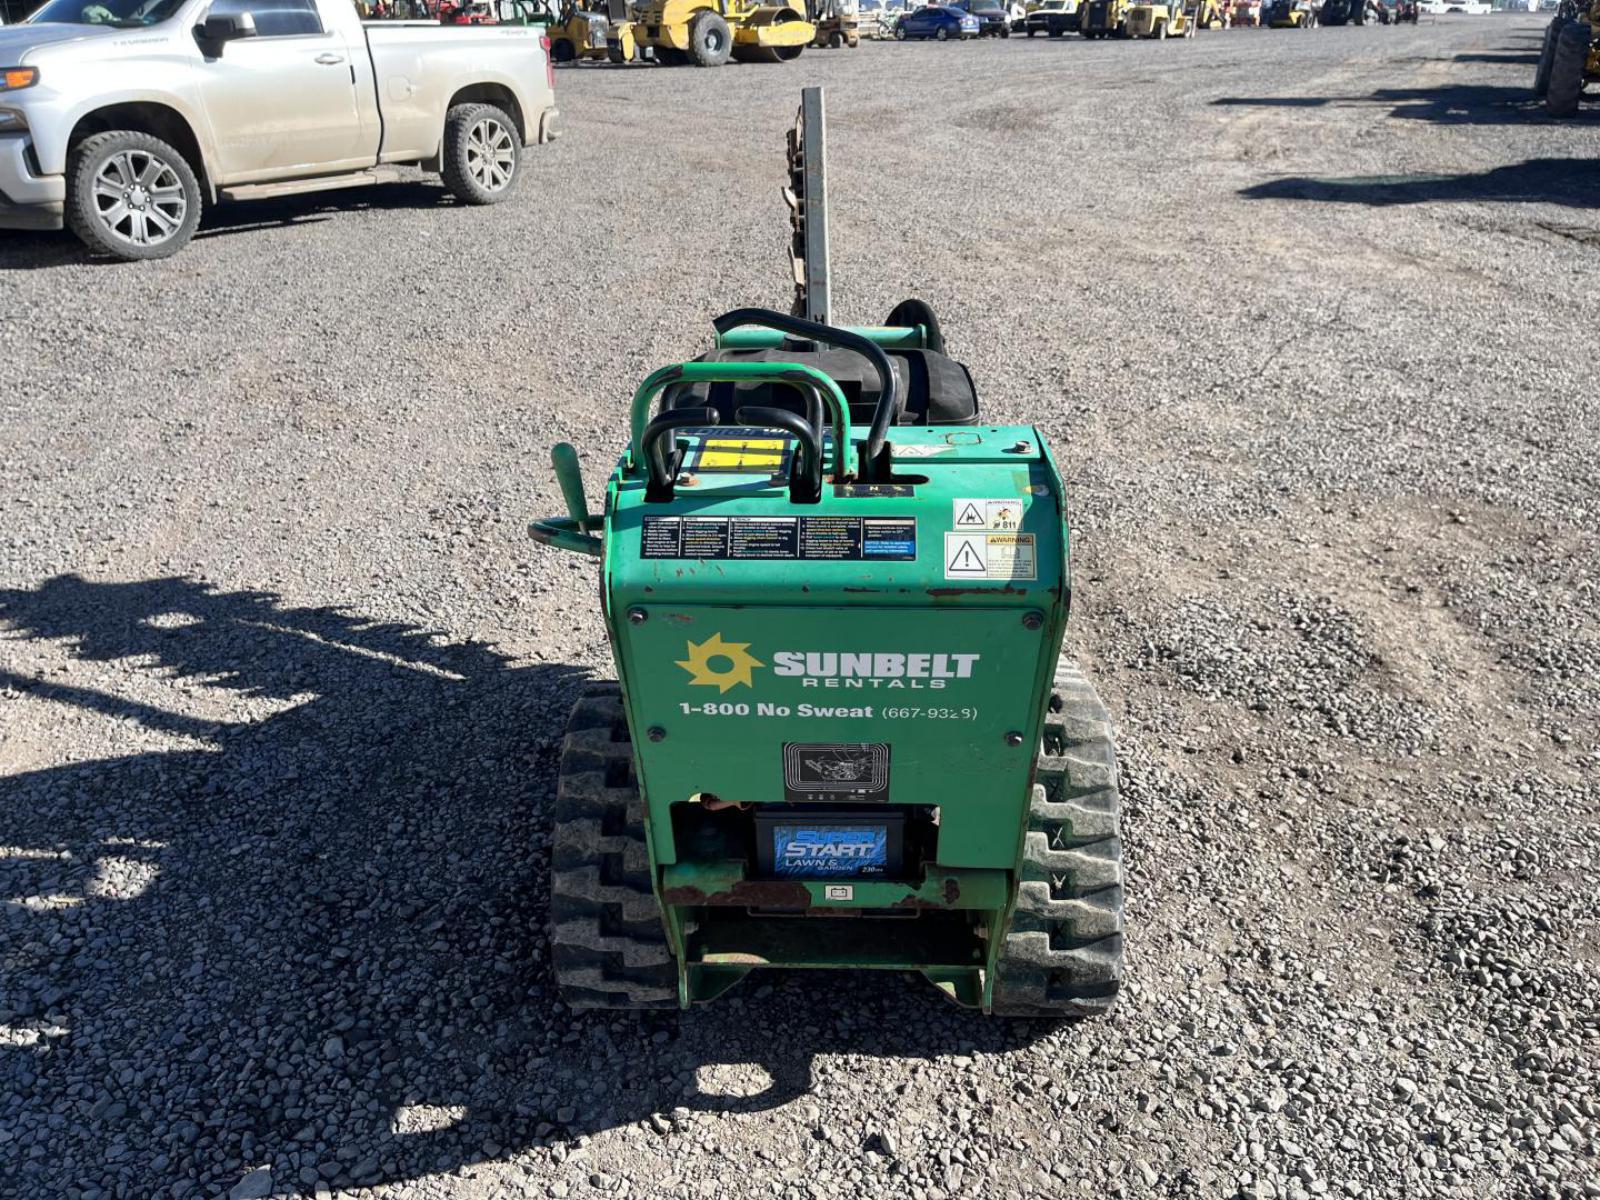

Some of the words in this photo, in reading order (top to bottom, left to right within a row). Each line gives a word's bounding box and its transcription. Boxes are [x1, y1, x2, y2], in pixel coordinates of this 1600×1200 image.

[1002, 521, 1017, 530] 811
[996, 536, 1032, 544] WARNING
[773, 651, 981, 679] SUNBELT
[802, 678, 947, 689] RENTALS
[680, 702, 750, 716] 1-800
[757, 702, 791, 717] No
[797, 703, 874, 718] Sweat
[784, 841, 876, 857] START
[785, 859, 826, 867] LAWN
